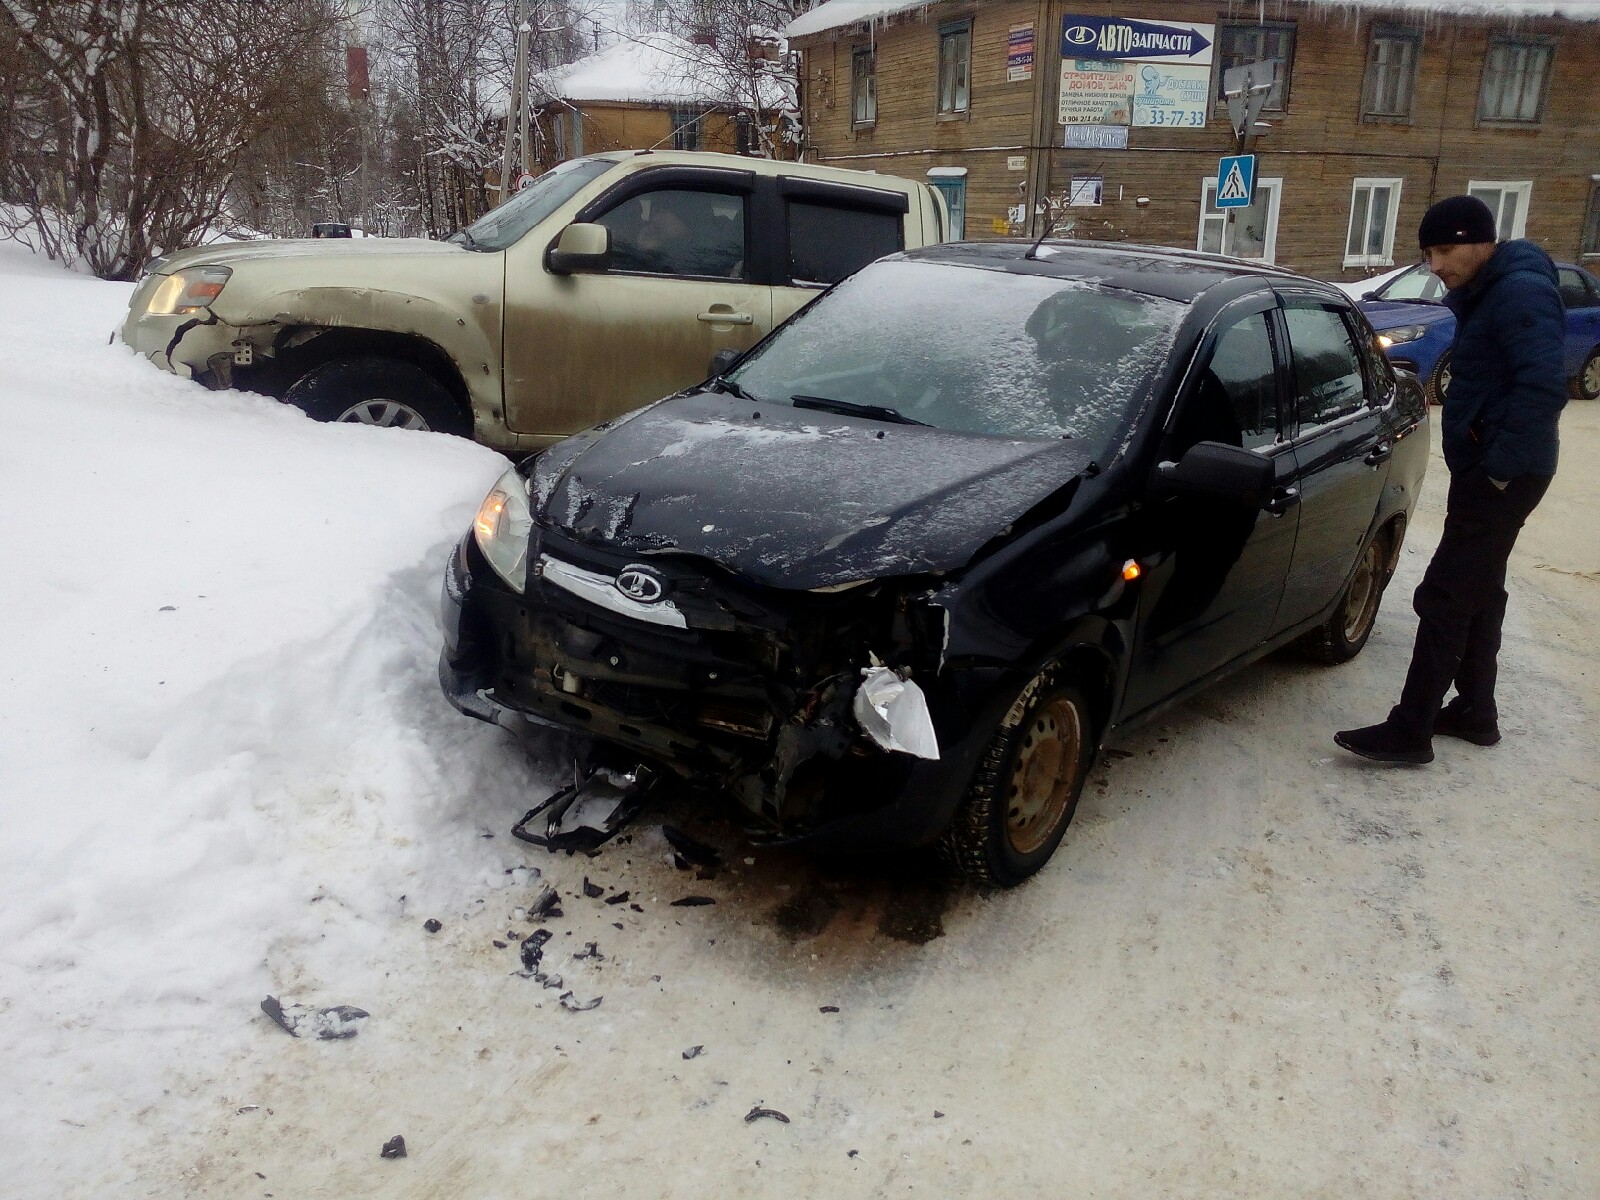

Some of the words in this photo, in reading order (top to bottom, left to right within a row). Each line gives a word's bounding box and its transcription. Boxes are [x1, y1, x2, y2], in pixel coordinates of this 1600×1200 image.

[1063, 72, 1134, 82] СТРОИТЕЛЬВО
[1181, 90, 1207, 103] СУШИ
[1149, 109, 1205, 126] 33-77-33
